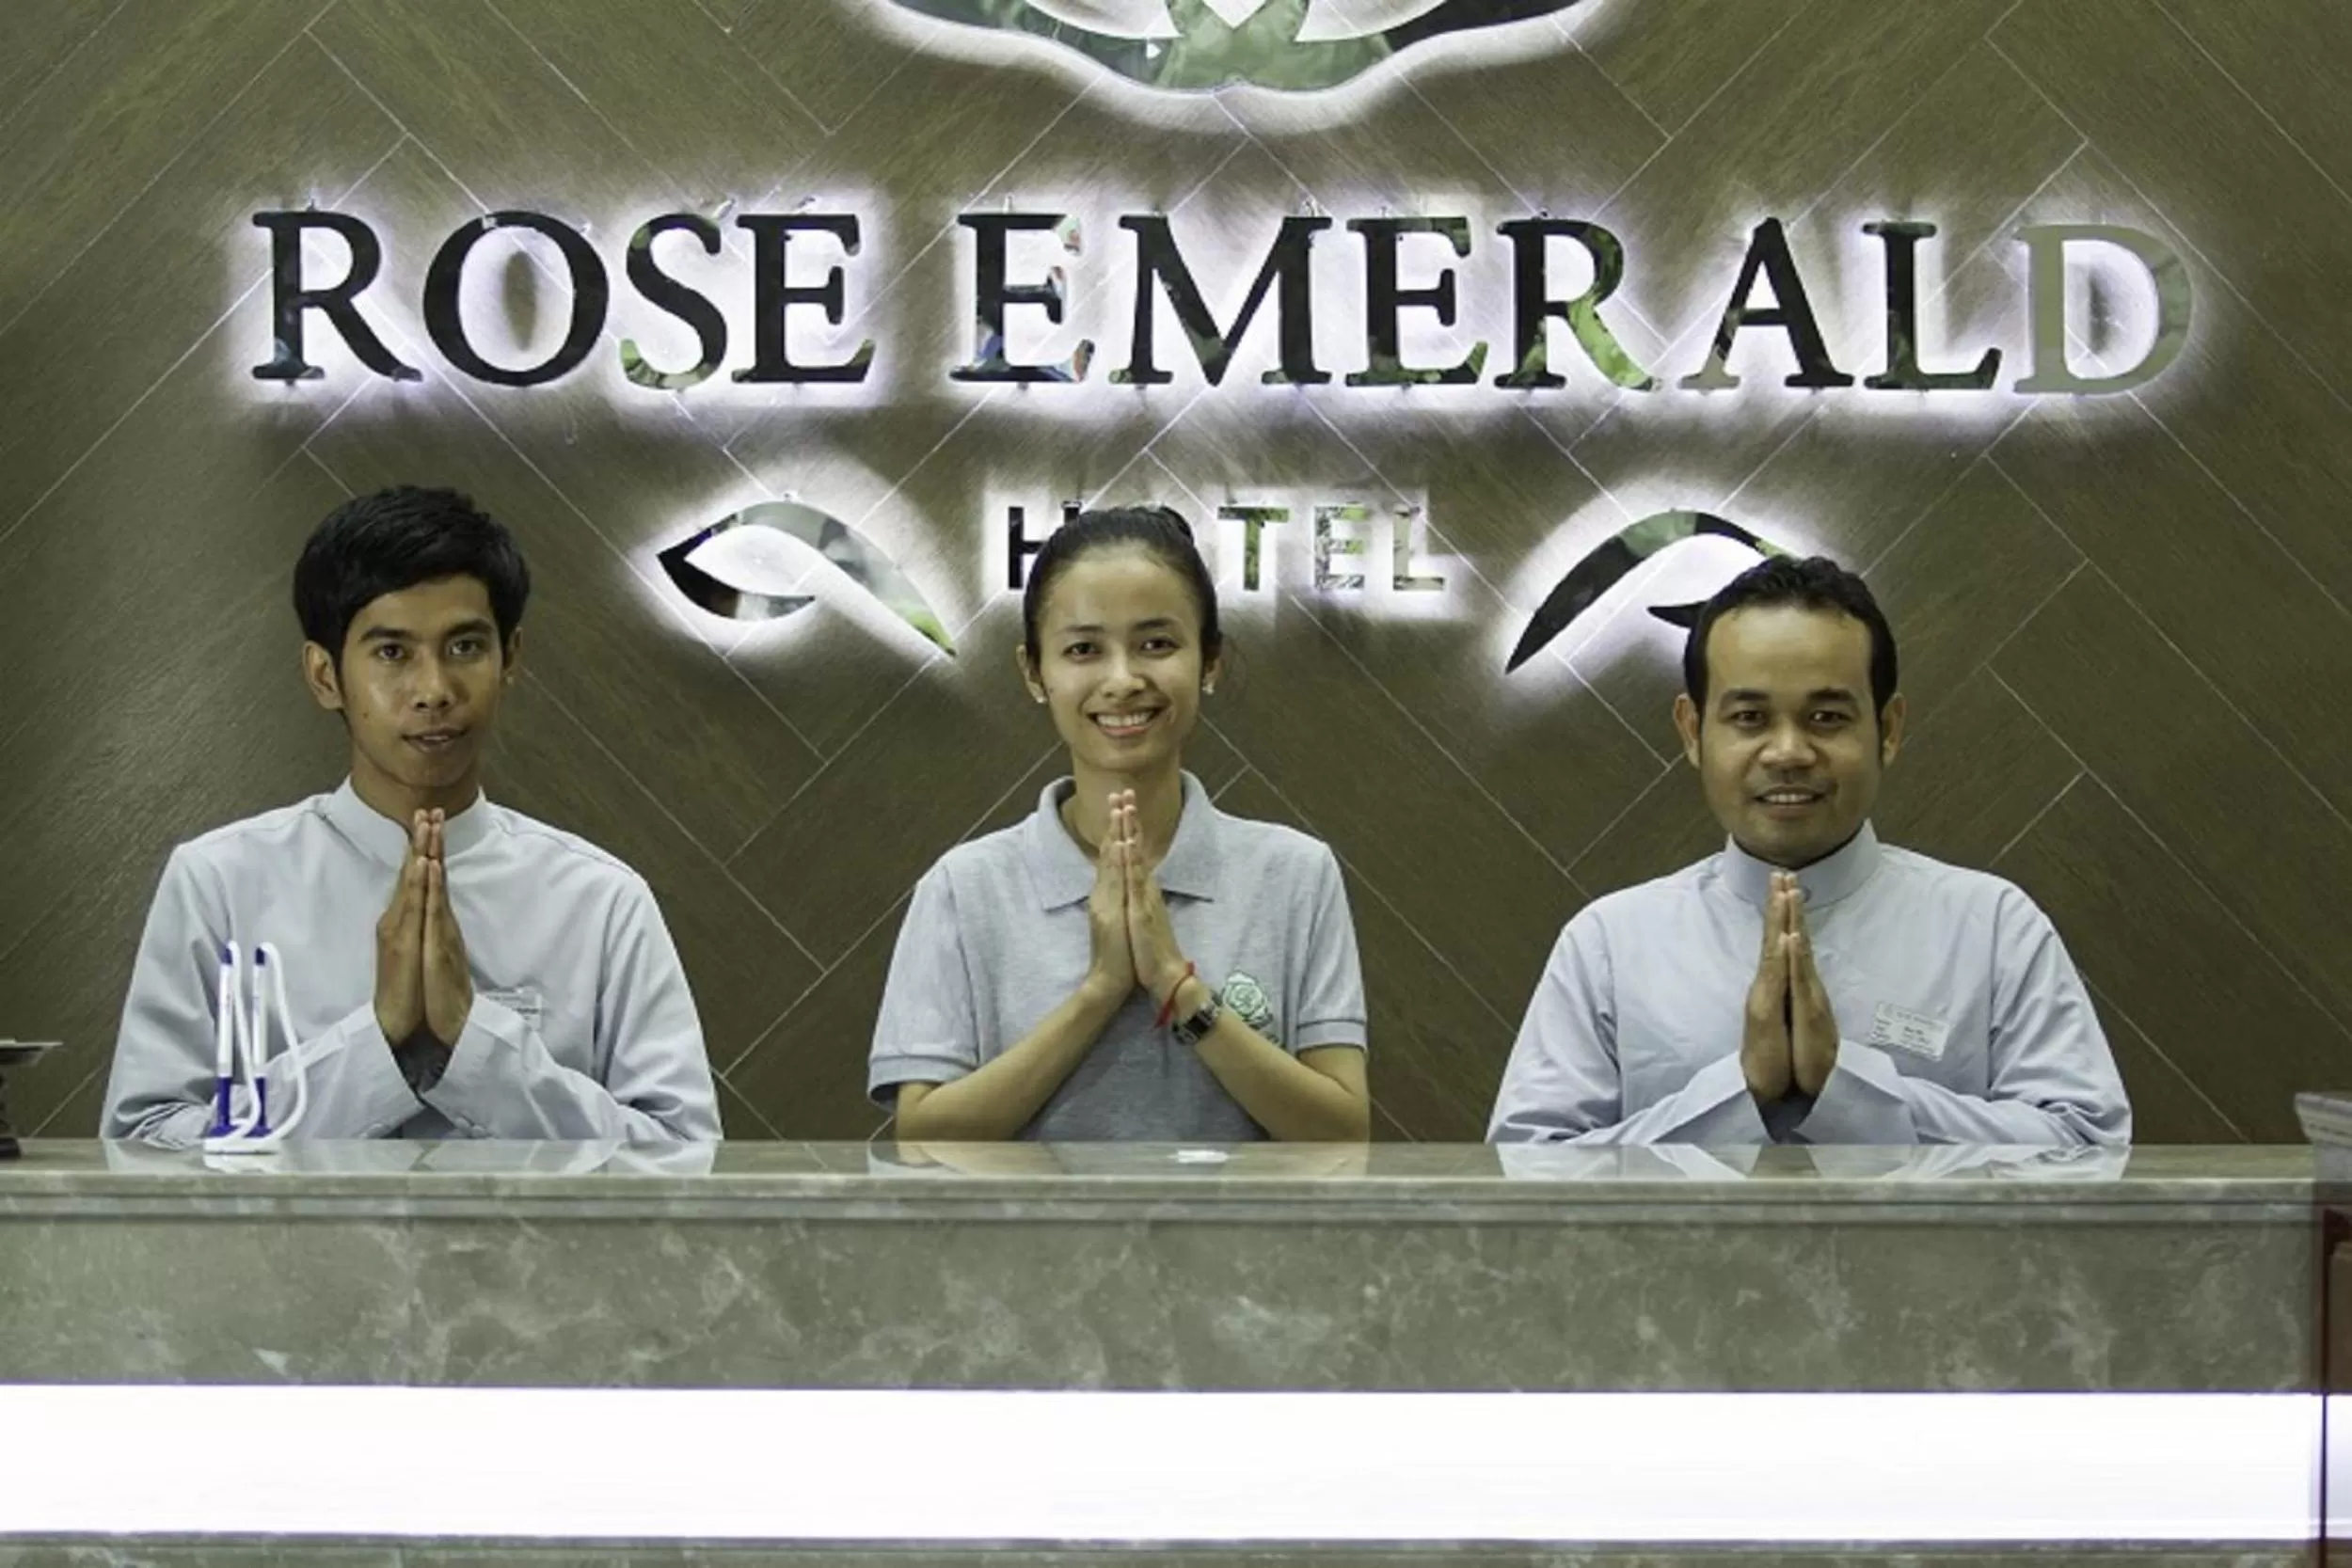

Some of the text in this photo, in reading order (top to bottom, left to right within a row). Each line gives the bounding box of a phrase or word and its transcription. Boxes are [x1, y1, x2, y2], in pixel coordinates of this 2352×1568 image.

[251, 210, 2195, 394] ROSE EMERALD
[1008, 504, 1444, 591] HTEL
